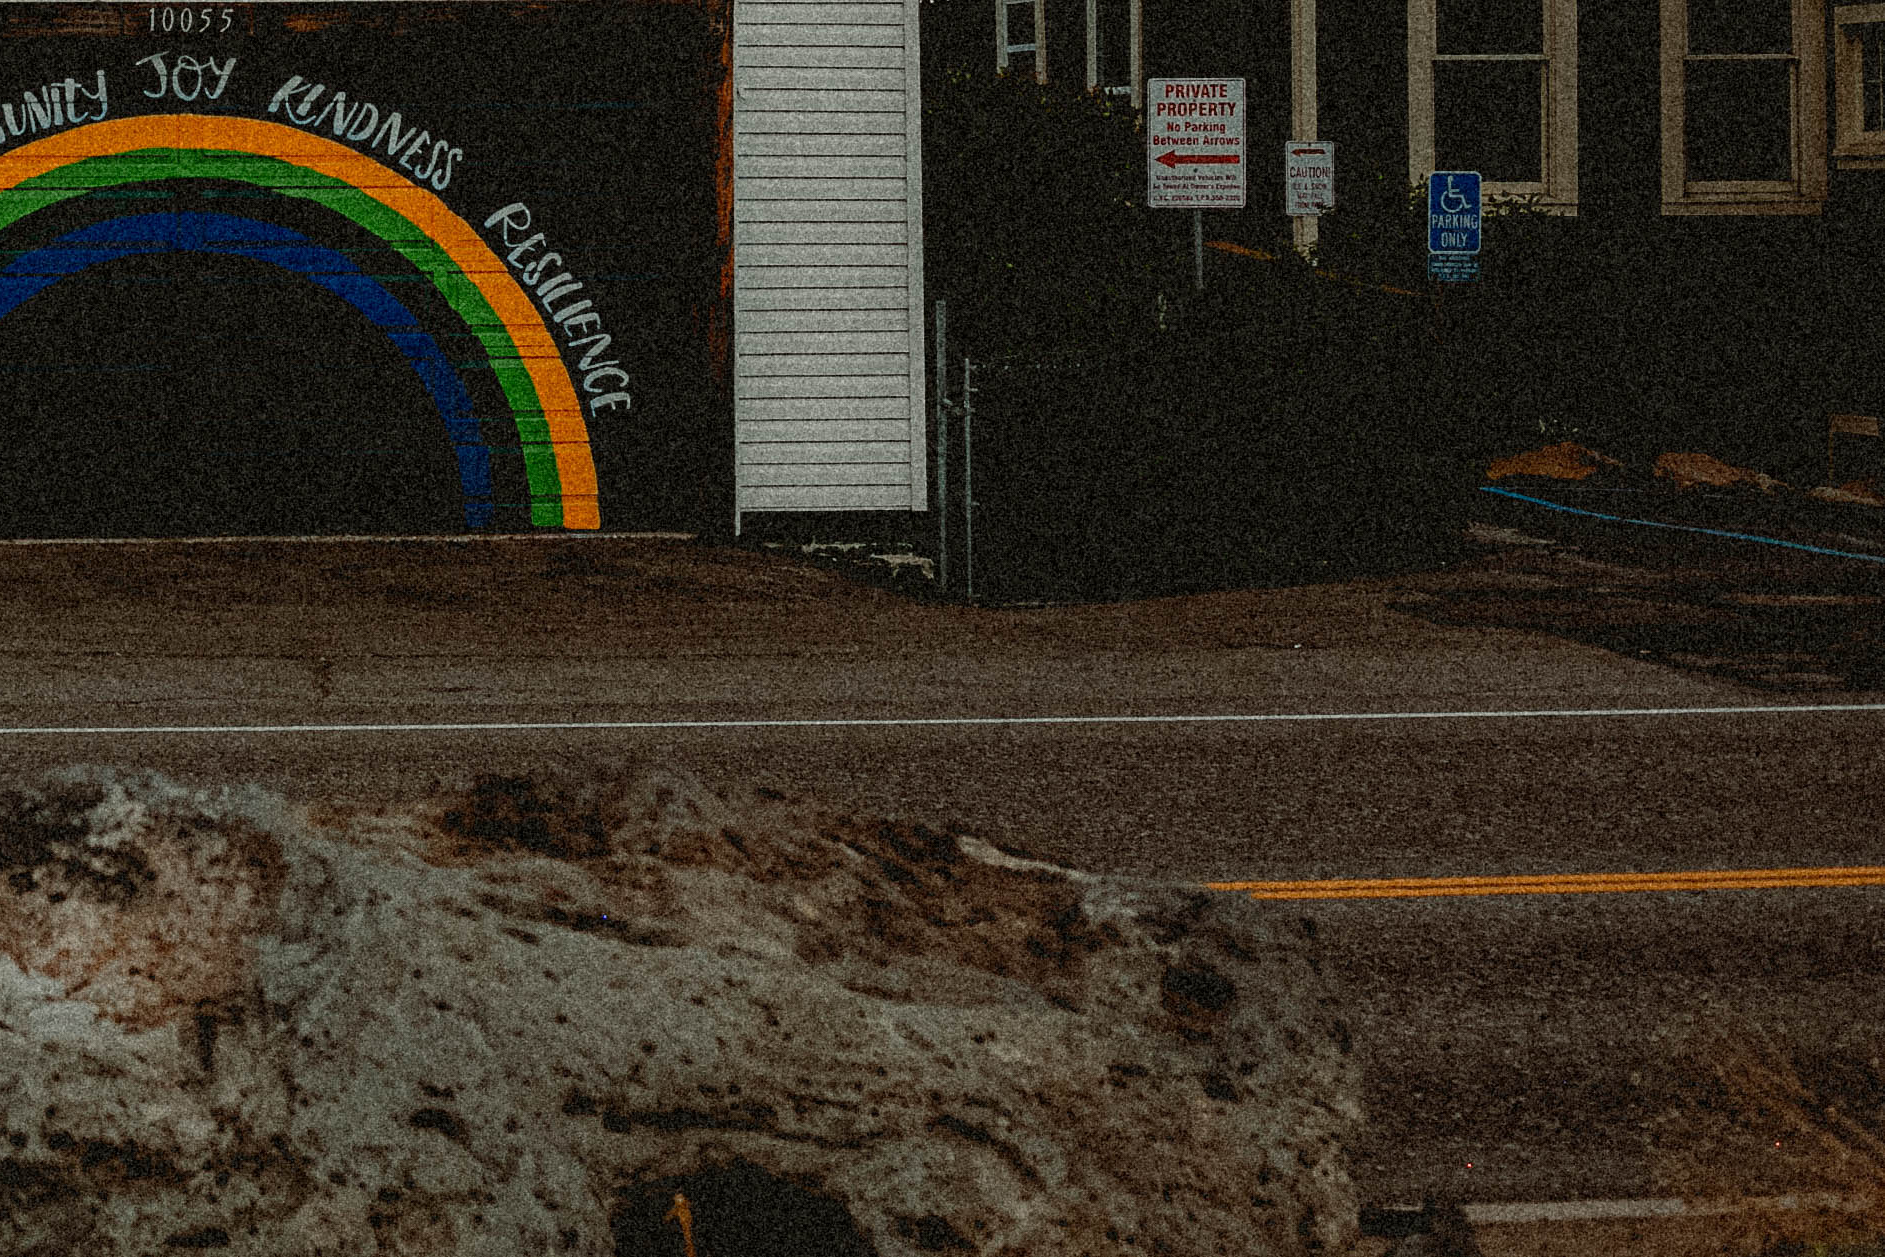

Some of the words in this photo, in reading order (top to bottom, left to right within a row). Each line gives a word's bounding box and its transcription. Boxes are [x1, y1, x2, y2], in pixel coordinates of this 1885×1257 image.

[147, 6, 236, 34] 10055
[1165, 84, 1228, 98] PRIVATE
[1157, 102, 1236, 117] PROPERTY
[1167, 122, 1181, 132] No
[1185, 122, 1226, 134] Parking
[1153, 135, 1199, 146] Between
[1203, 135, 1240, 145] Arrows
[1432, 215, 1478, 229] PARKING
[135, 53, 237, 101] JOY
[268, 74, 464, 192] KINDNESS
[485, 201, 632, 419] RESILIENCE
[1441, 232, 1468, 248] ONLY
